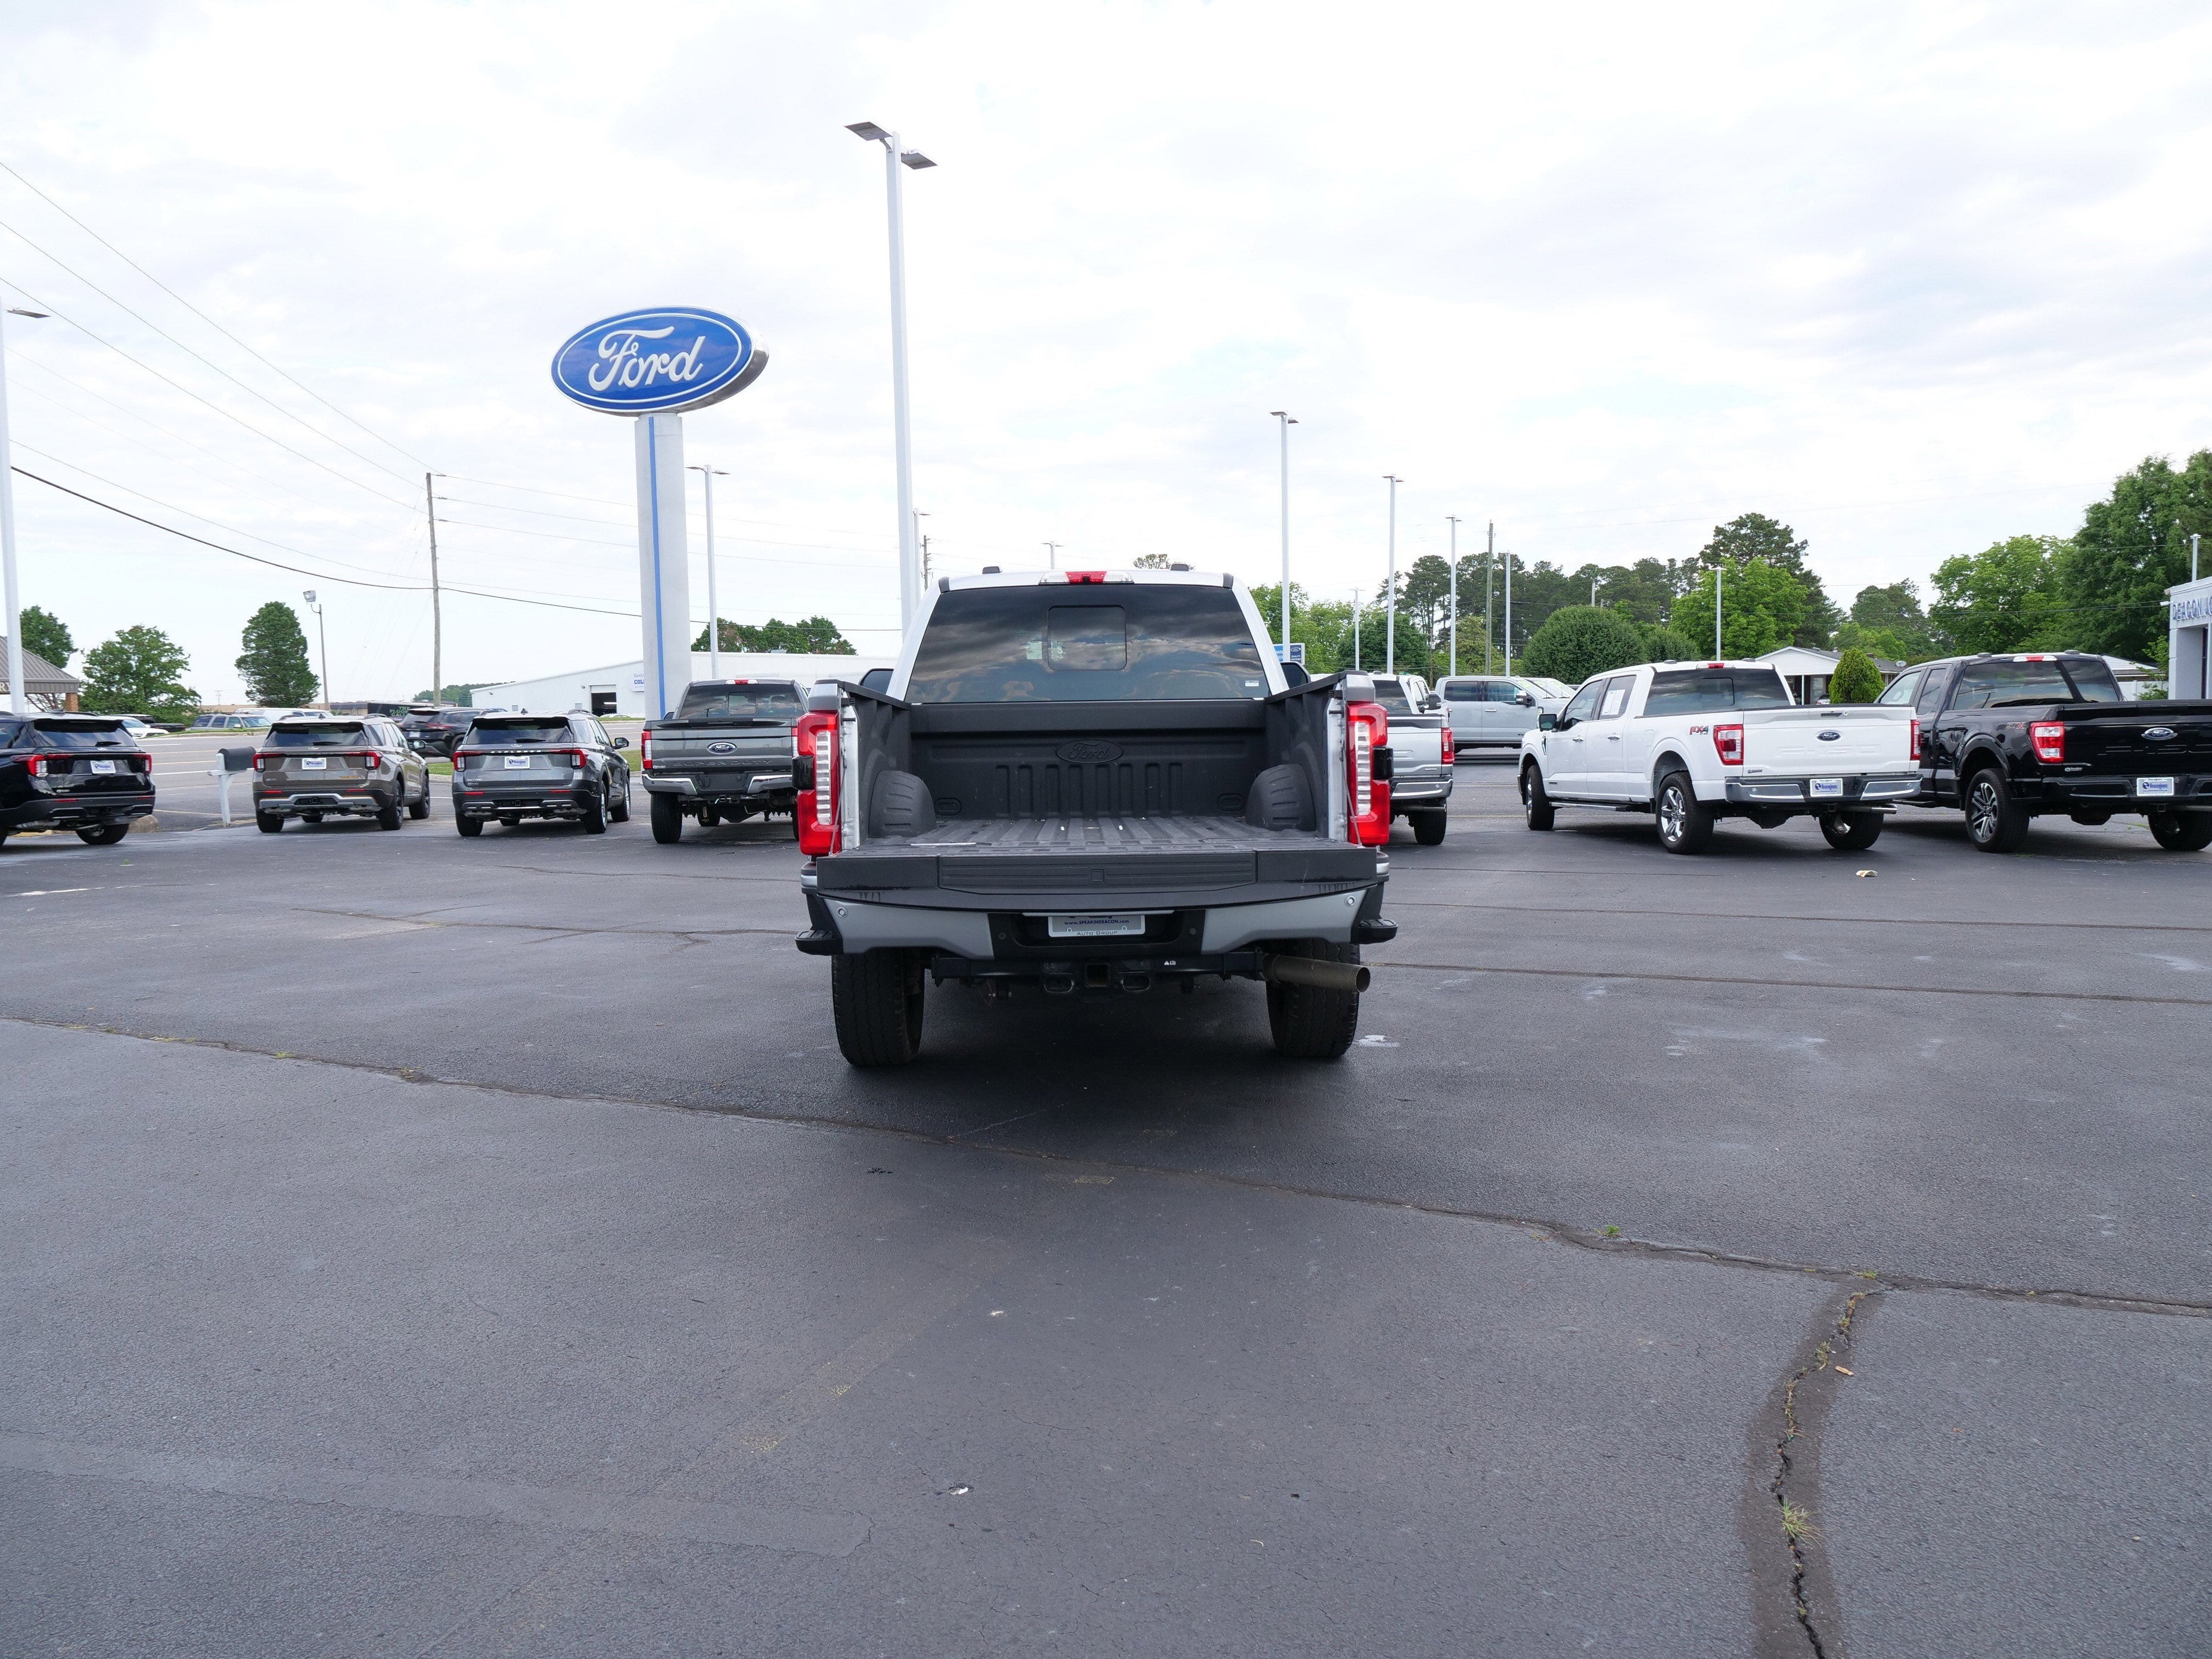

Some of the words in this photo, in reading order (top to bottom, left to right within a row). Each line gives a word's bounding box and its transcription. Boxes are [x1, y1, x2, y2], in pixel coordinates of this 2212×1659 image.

[588, 326, 706, 392] Ford
[2173, 598, 2203, 621] DEACON
[1689, 725, 1709, 735] FX4
[1068, 742, 1110, 759] Ford
